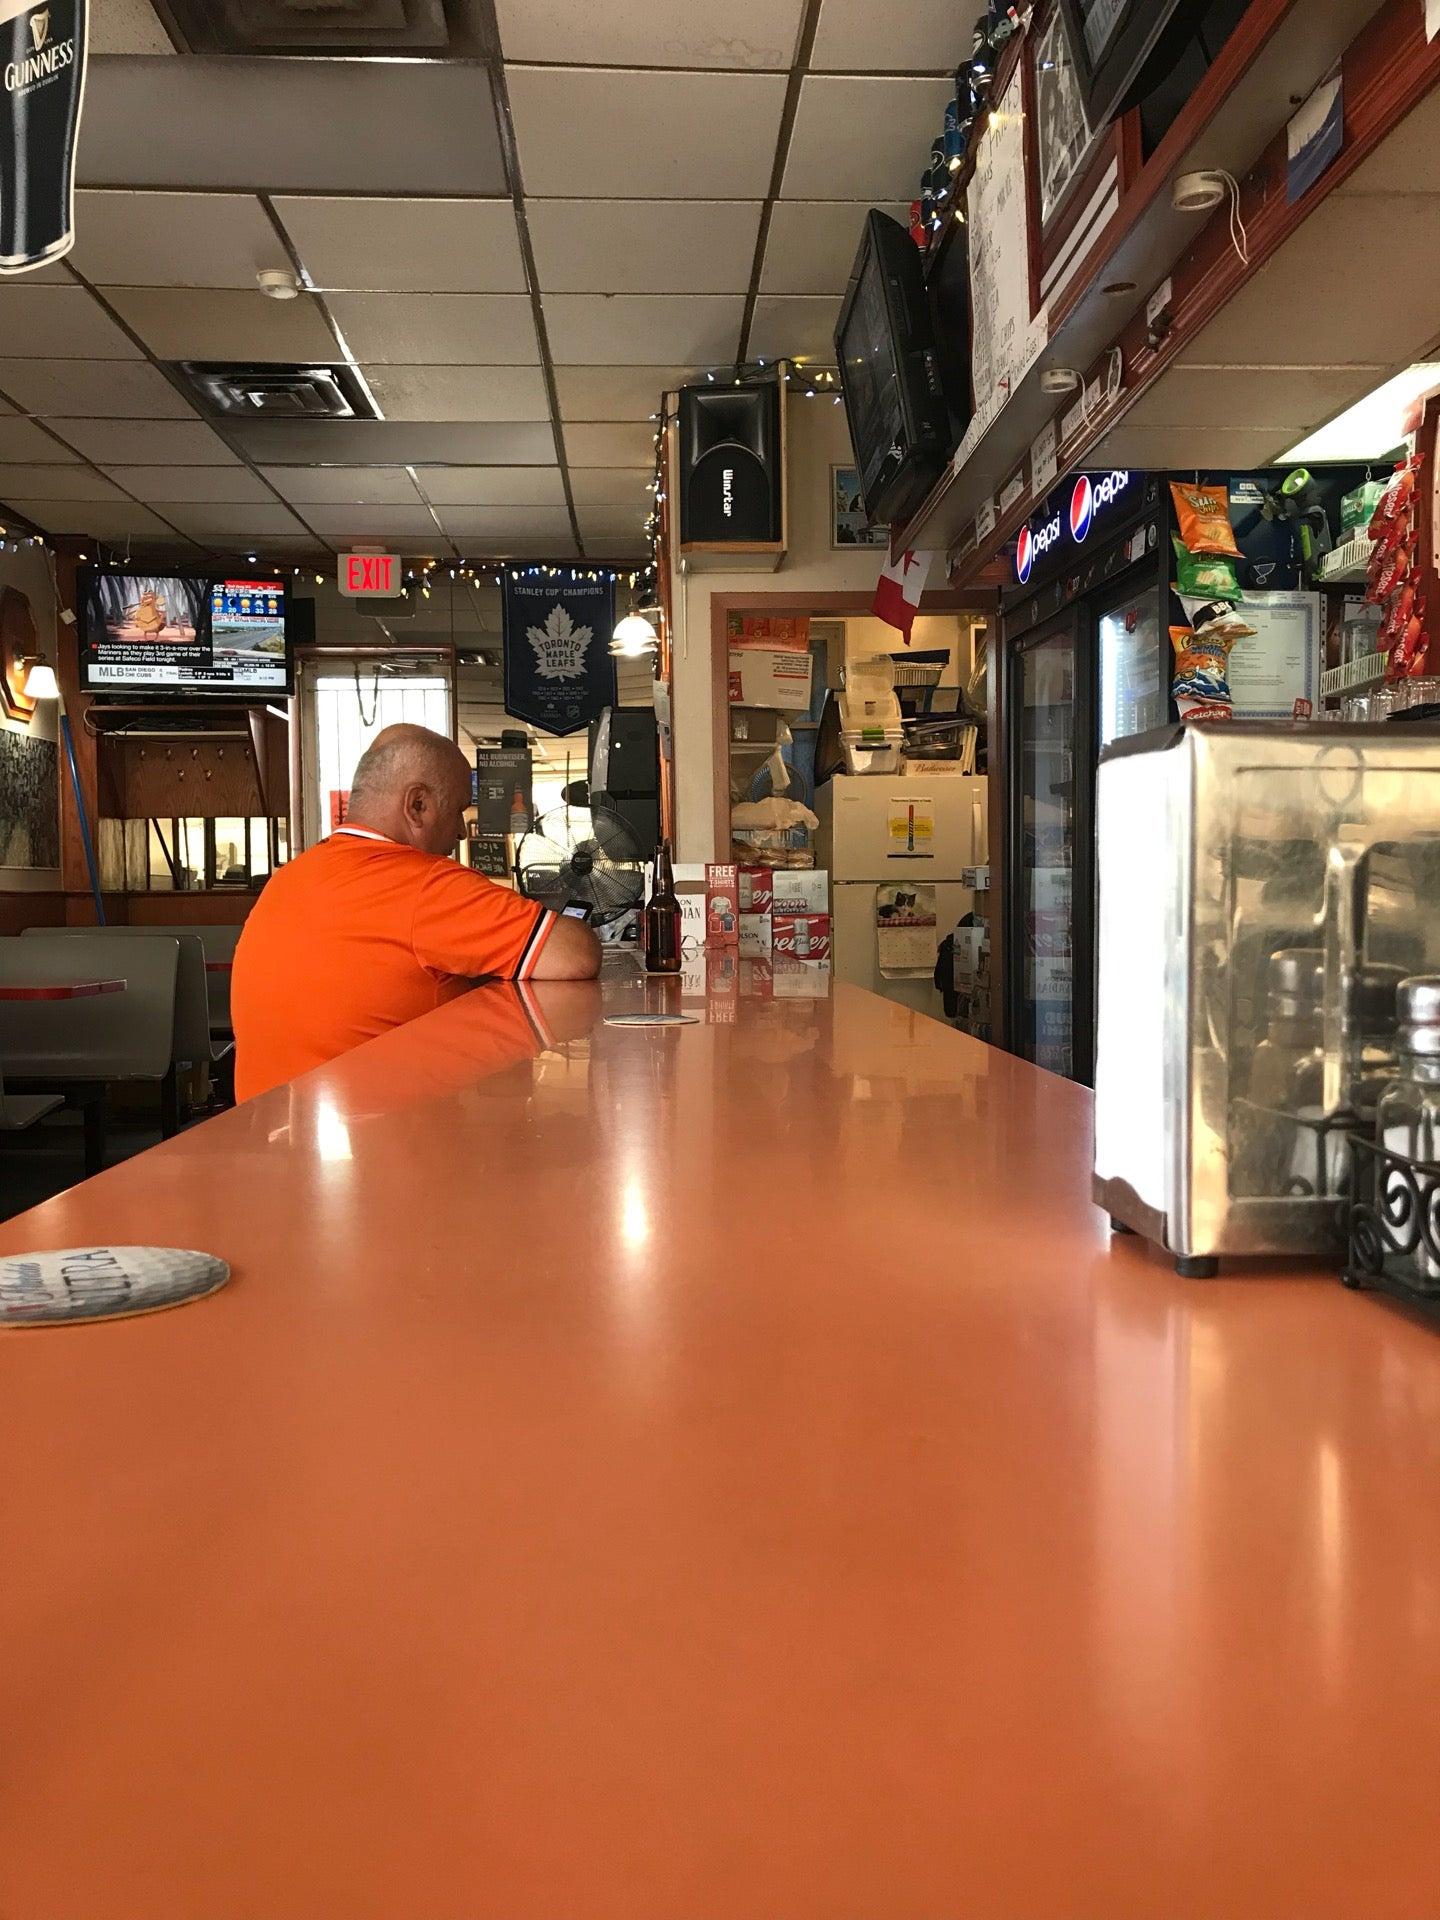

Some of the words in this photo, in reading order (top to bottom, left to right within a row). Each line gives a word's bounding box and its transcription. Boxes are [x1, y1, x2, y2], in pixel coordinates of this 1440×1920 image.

[5, 38, 74, 91] GUINNESS
[722, 469, 734, 517] Winstar
[1092, 471, 1129, 516] pepsi
[1032, 511, 1060, 562] pepsi
[346, 556, 393, 592] EXIT
[514, 587, 543, 596] STANLEY
[546, 588, 559, 596] CUP
[564, 587, 604, 596] CHAMPIONS
[98, 643, 110, 651] Jays
[112, 643, 131, 651] looking
[539, 639, 582, 652] TORONTO
[546, 651, 575, 659] MAPLE
[547, 658, 576, 667] LEAFS
[99, 667, 125, 677] MLB
[480, 760, 488, 768] NO
[709, 865, 735, 877] FREE
[61, 1249, 132, 1307] ULTRA
